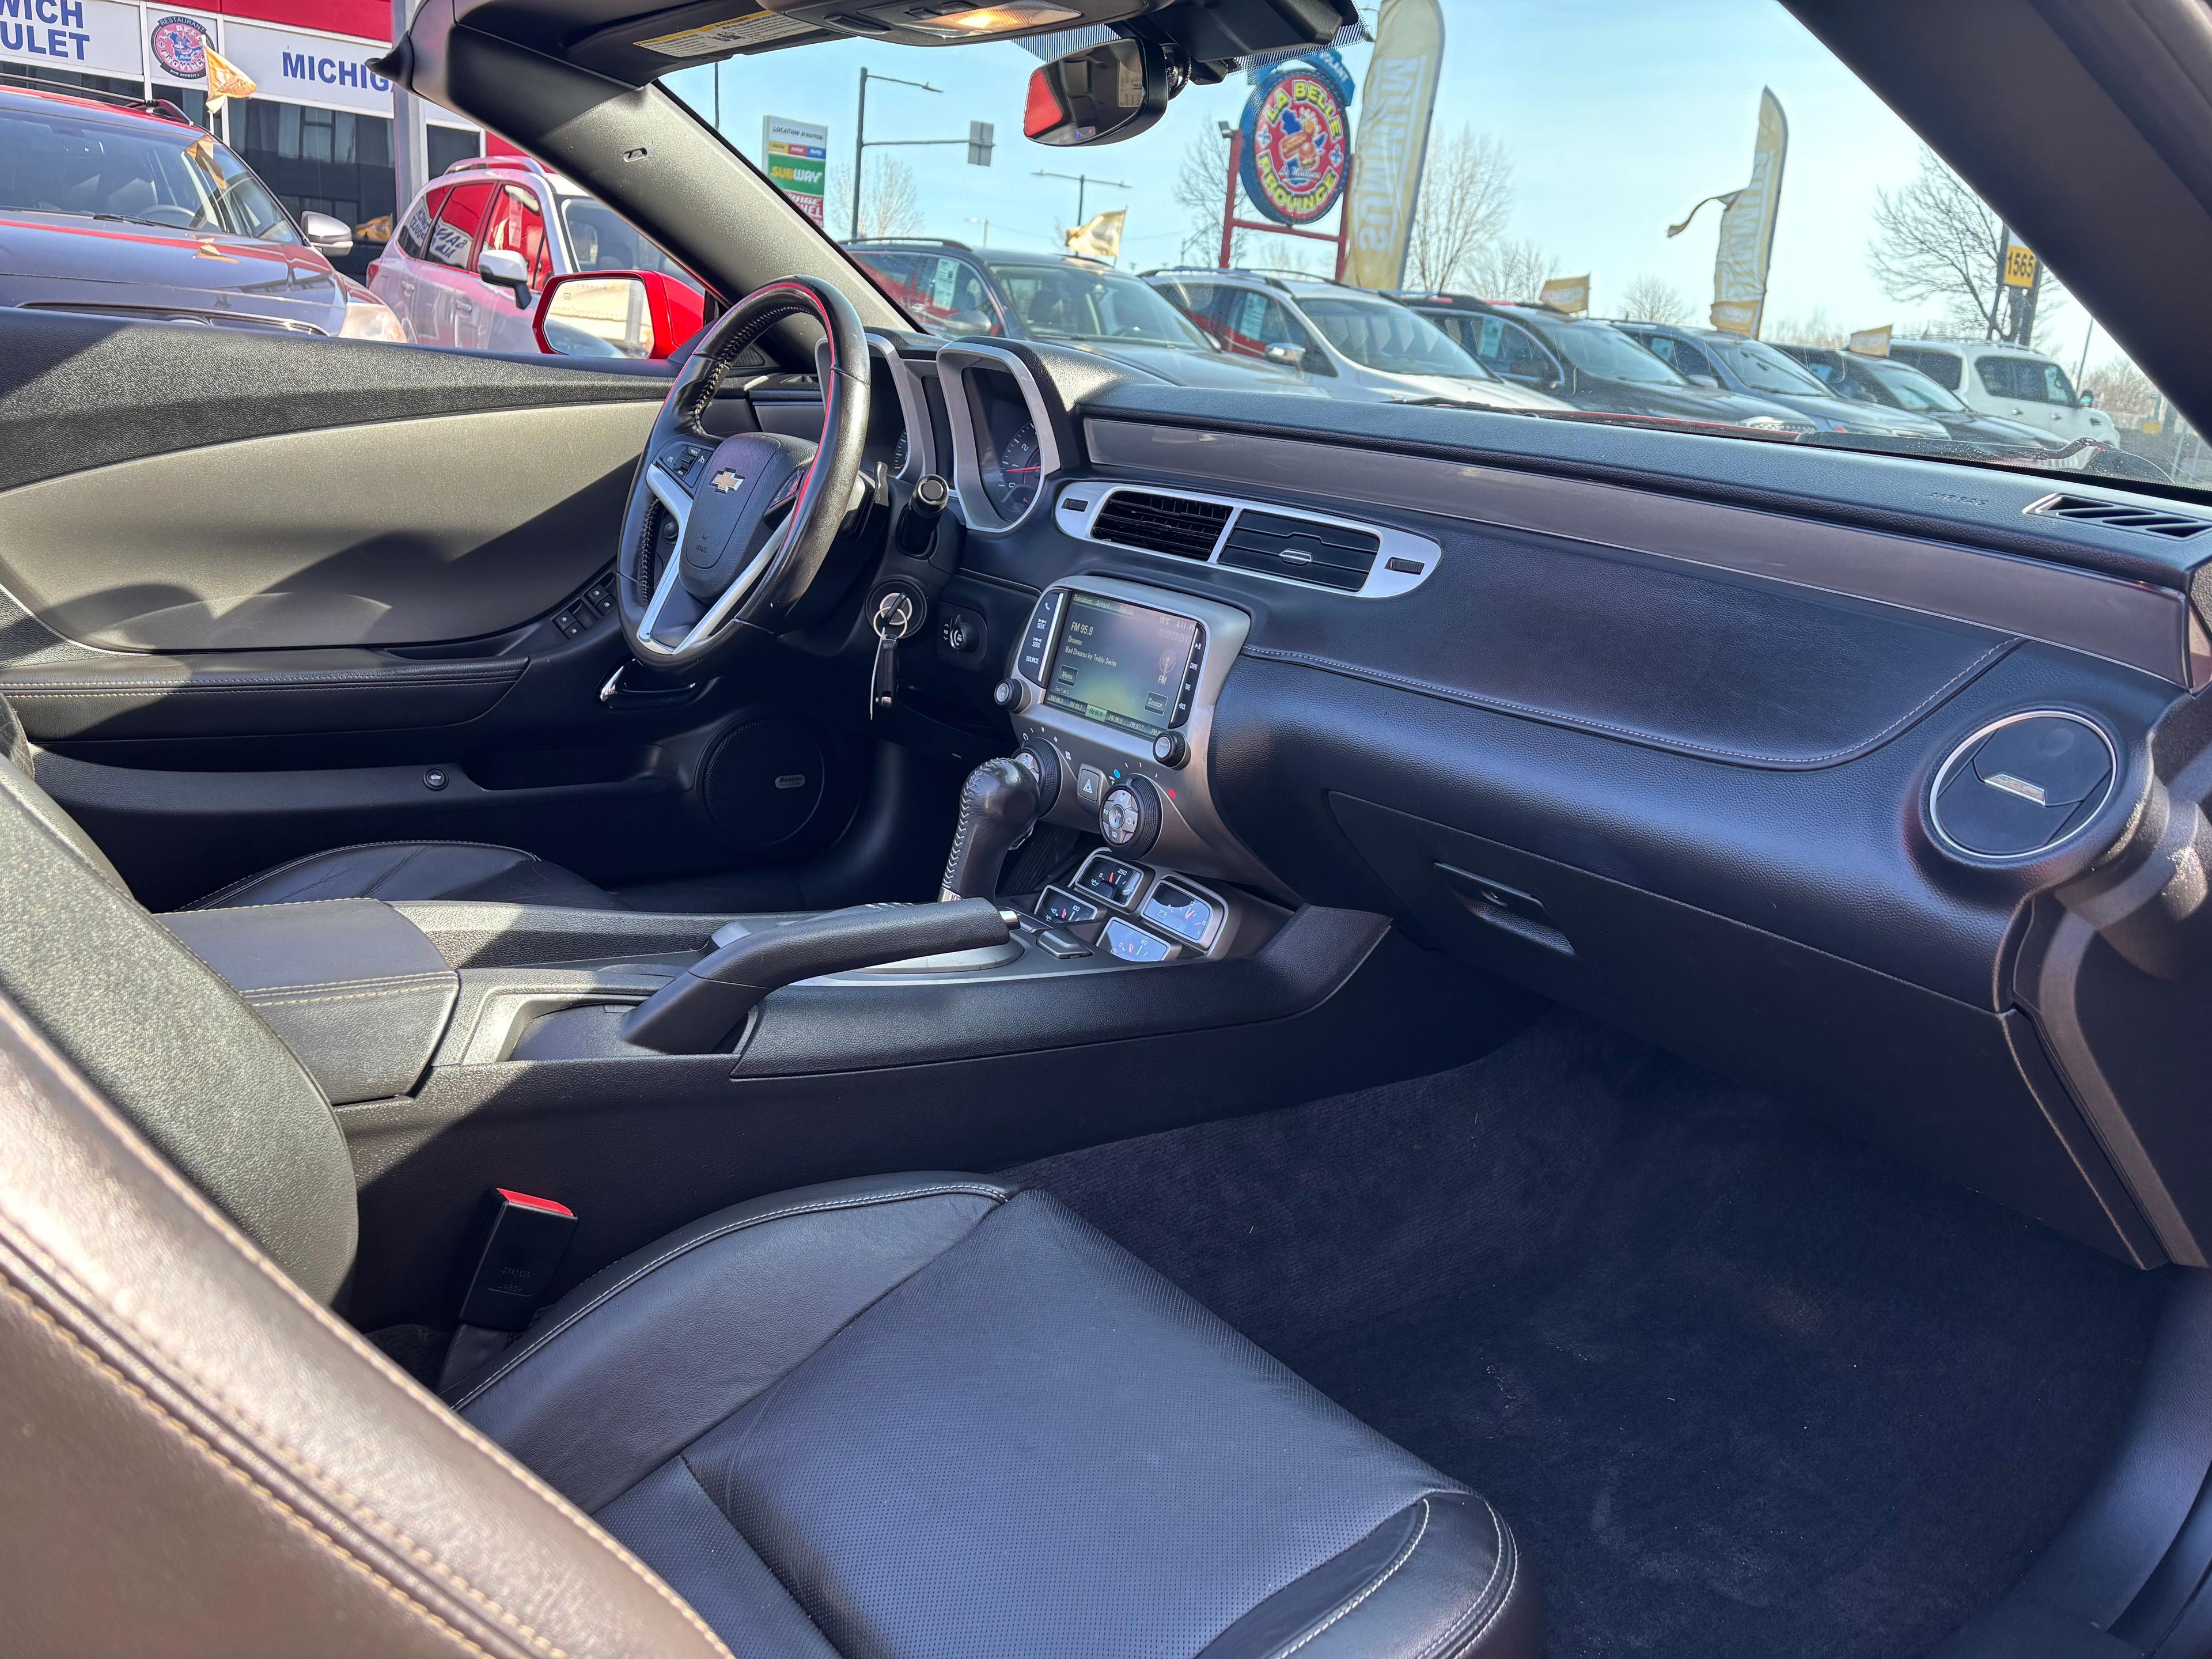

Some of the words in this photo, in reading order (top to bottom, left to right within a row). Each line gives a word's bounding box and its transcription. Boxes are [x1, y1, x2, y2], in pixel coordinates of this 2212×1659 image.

[160, 17, 205, 32] RESTAURANT
[1267, 90, 1291, 124] LA
[1294, 81, 1341, 137] BELLE
[771, 166, 823, 183] SUBWAY
[1259, 154, 1337, 211] PROVINCE
[2008, 250, 2035, 277] 1565
[1071, 622, 1080, 632] FM
[1081, 624, 1093, 635] 95.9
[1067, 635, 1082, 645] Dreams
[1025, 656, 1040, 664] SOURCE
[1073, 647, 1088, 658] Dreams
[1088, 652, 1093, 661] by
[1093, 654, 1105, 664] Teddy
[1062, 671, 1073, 680] Menu
[1158, 675, 1167, 685] FM
[1147, 698, 1163, 709] Source
